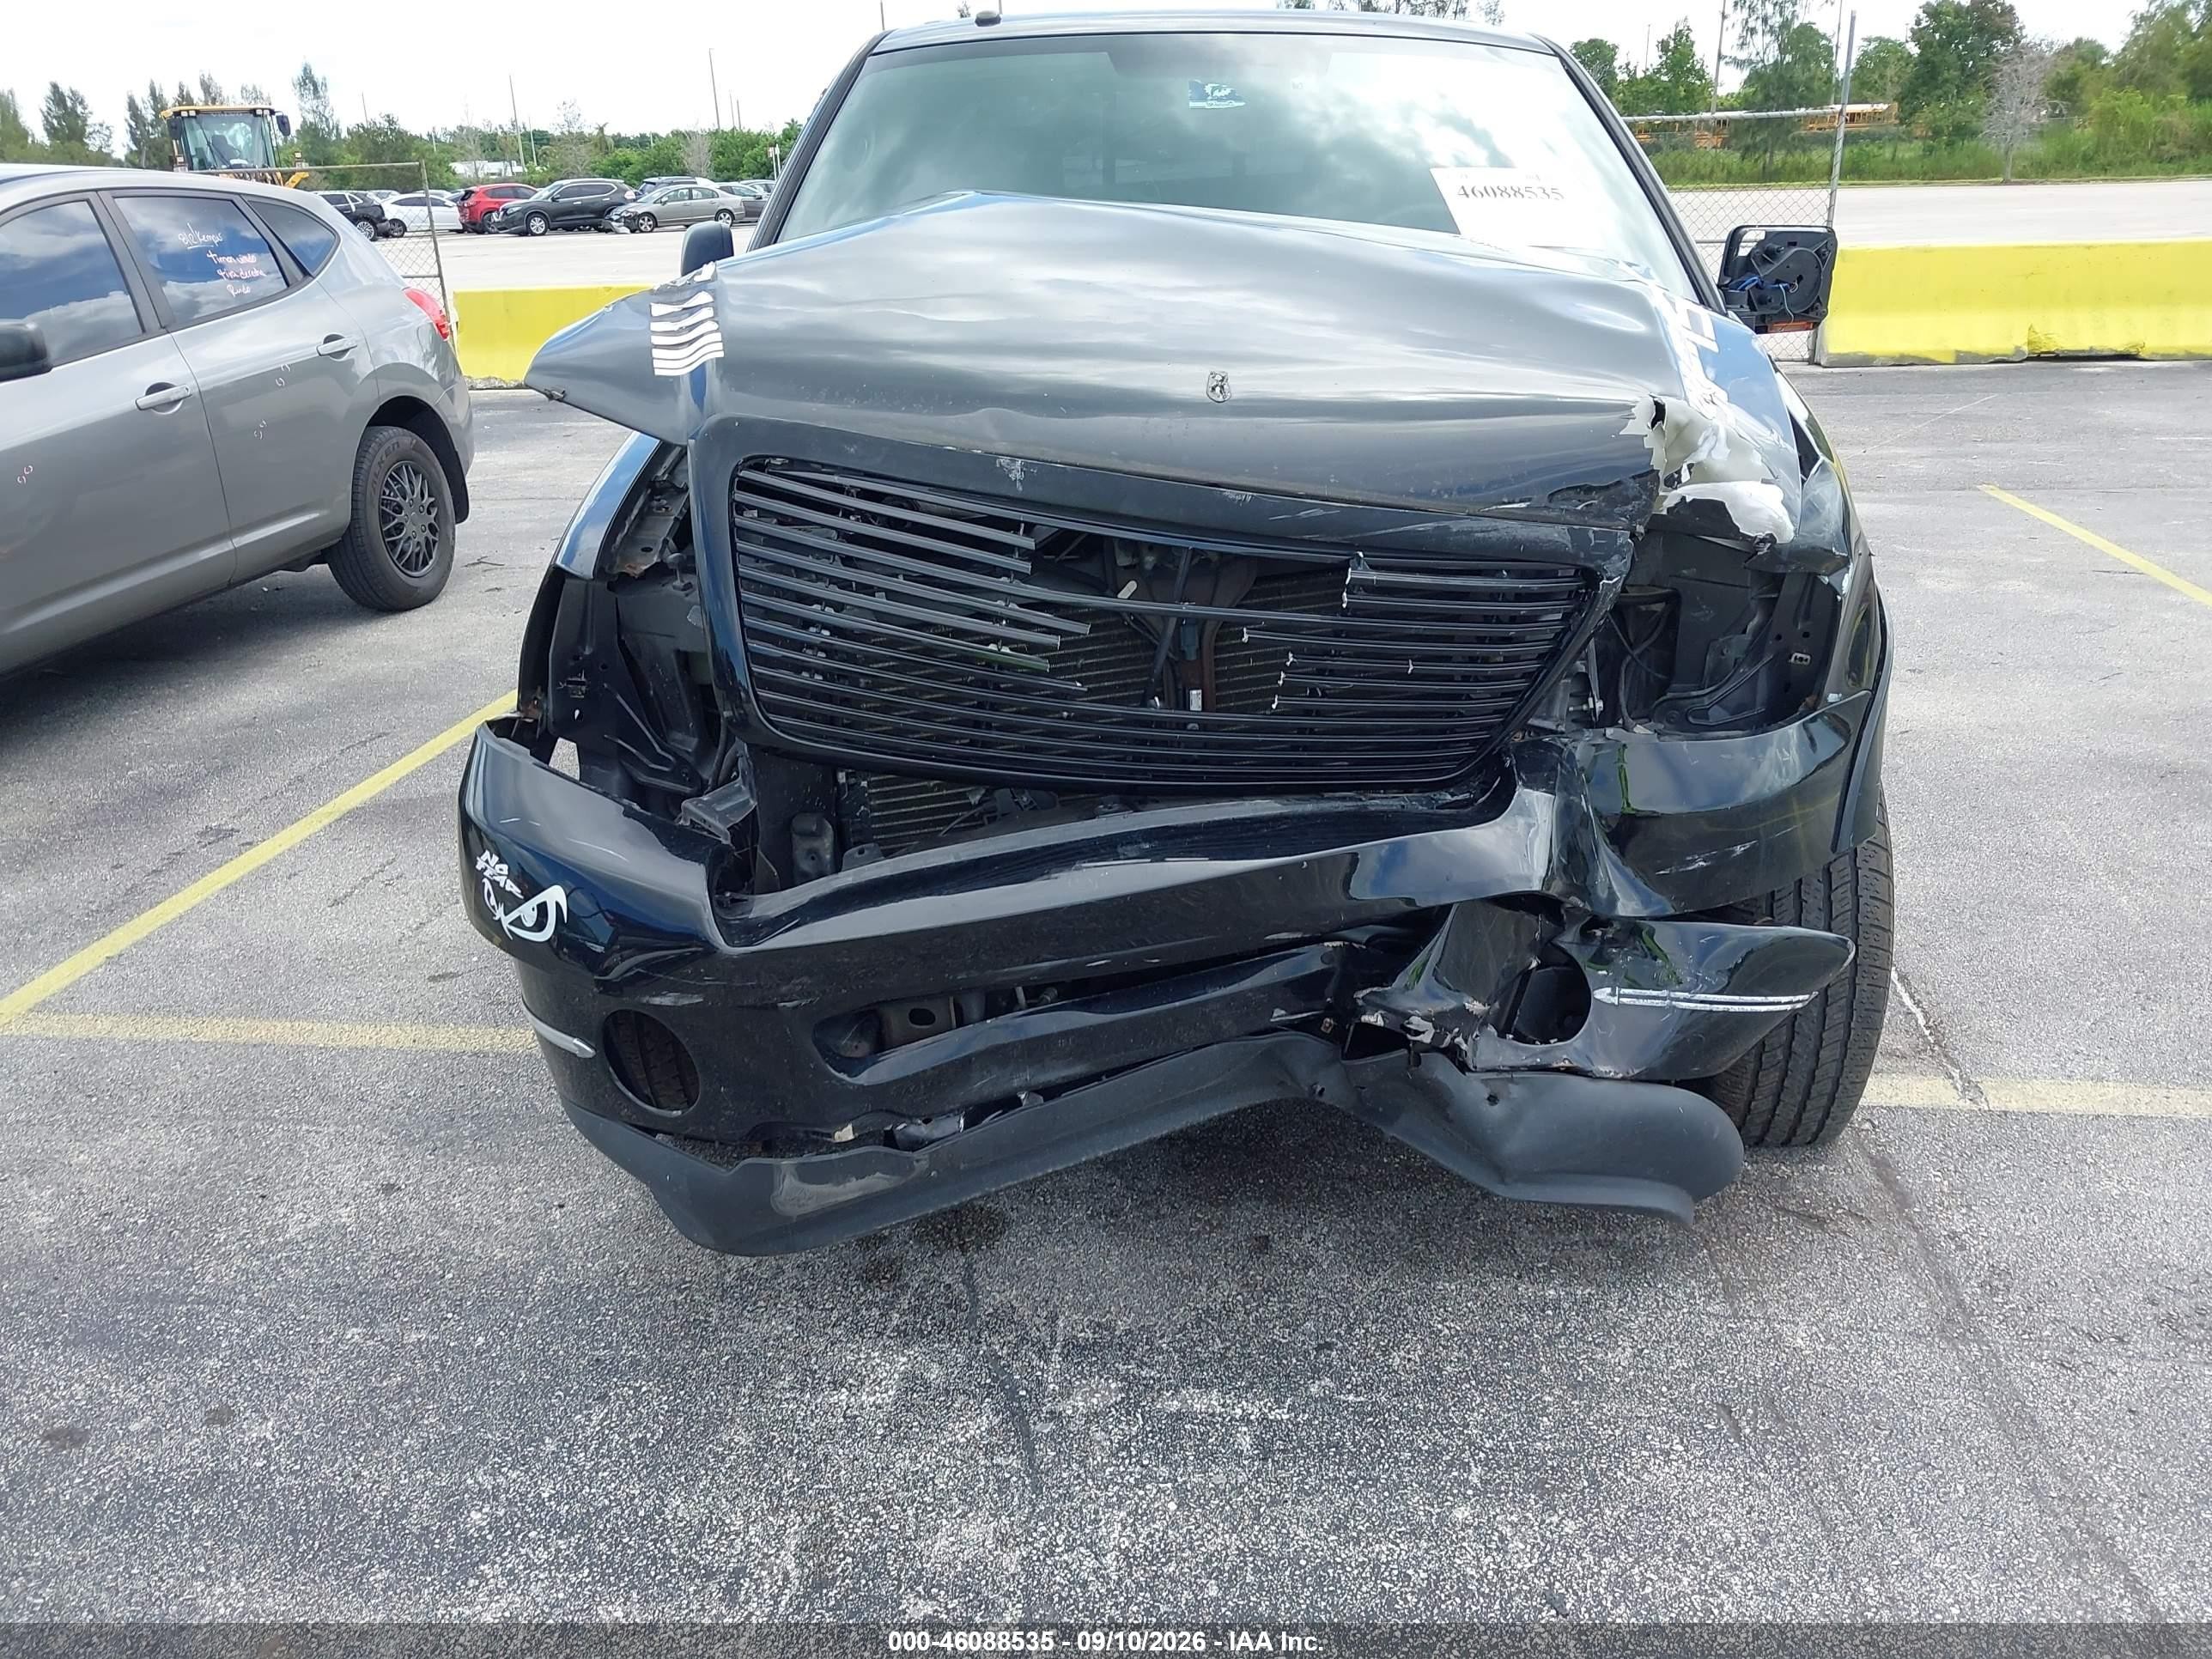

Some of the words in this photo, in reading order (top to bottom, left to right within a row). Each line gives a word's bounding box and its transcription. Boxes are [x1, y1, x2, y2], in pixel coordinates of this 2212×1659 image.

[1457, 185, 1565, 201] 46088535
[480, 849, 509, 875] NO
[475, 856, 525, 900] FEAR
